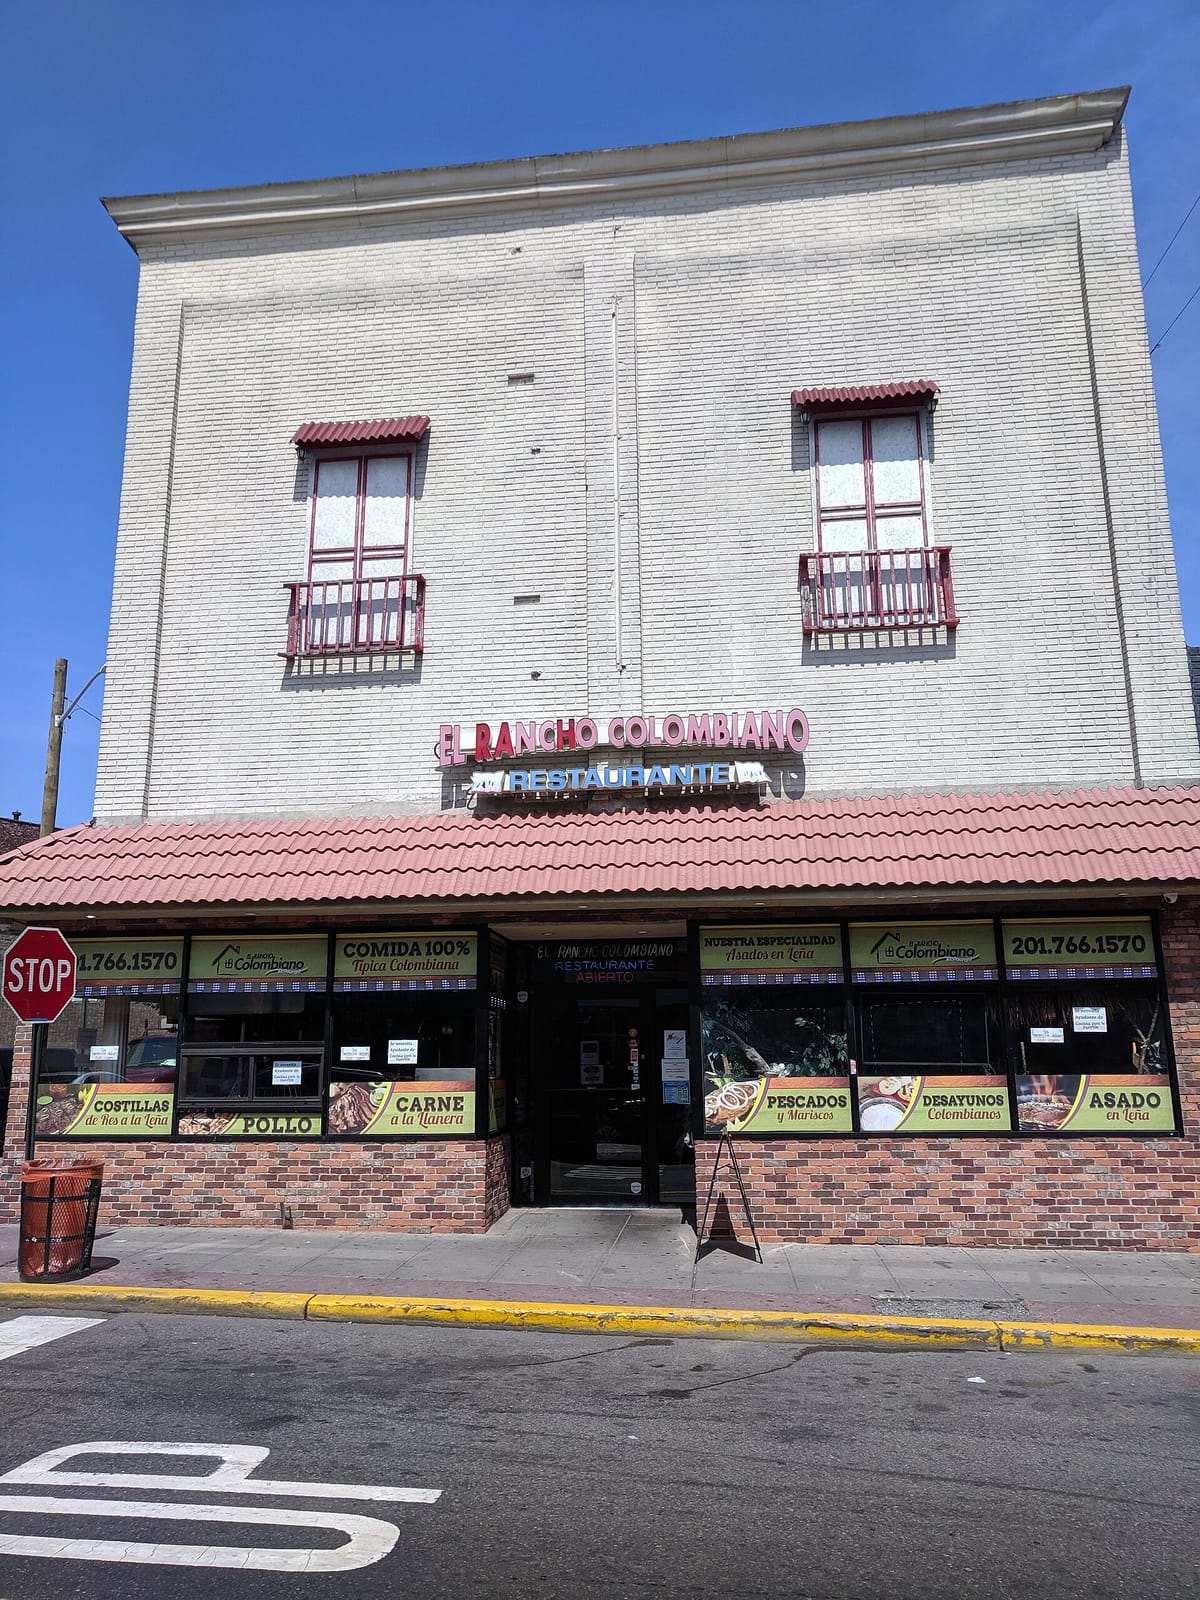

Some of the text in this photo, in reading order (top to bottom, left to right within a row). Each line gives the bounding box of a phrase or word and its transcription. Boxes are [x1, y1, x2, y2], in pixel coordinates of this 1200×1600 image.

[439, 708, 809, 768] EL RANCHO COLOMBIANO
[509, 762, 730, 791] RESTAURANTE
[343, 940, 470, 958] COMIDA 100%
[704, 935, 836, 948] NUESTRA ESPECIALIDAD
[1011, 934, 1146, 956] 201.766.1570
[537, 945, 552, 959] EL
[602, 943, 674, 958] COLOMBIANO
[726, 946, 815, 963] Asados en Leña
[896, 944, 975, 959] Colombiano
[77, 952, 178, 971] 1.766.1570
[234, 956, 305, 970] Colombiano
[389, 958, 460, 972] Colombiana
[554, 960, 656, 971] RESTAURANTE
[8, 957, 71, 992] STOP
[575, 972, 635, 984] ABIERTO
[94, 1100, 170, 1113] COSTILLAS
[396, 1096, 464, 1112] CARNE
[767, 1095, 848, 1109] PESCADOS
[923, 1094, 1004, 1107] DESAYUNOS
[1089, 1092, 1161, 1109] ASADO
[85, 1113, 168, 1129] de Res a la Leña
[390, 1111, 464, 1129] a la Llanera
[777, 1109, 834, 1124] y Mariscos
[928, 1107, 1001, 1120] Colombianos
[1106, 1107, 1150, 1124] en Leña
[242, 1116, 312, 1134] POLLO
